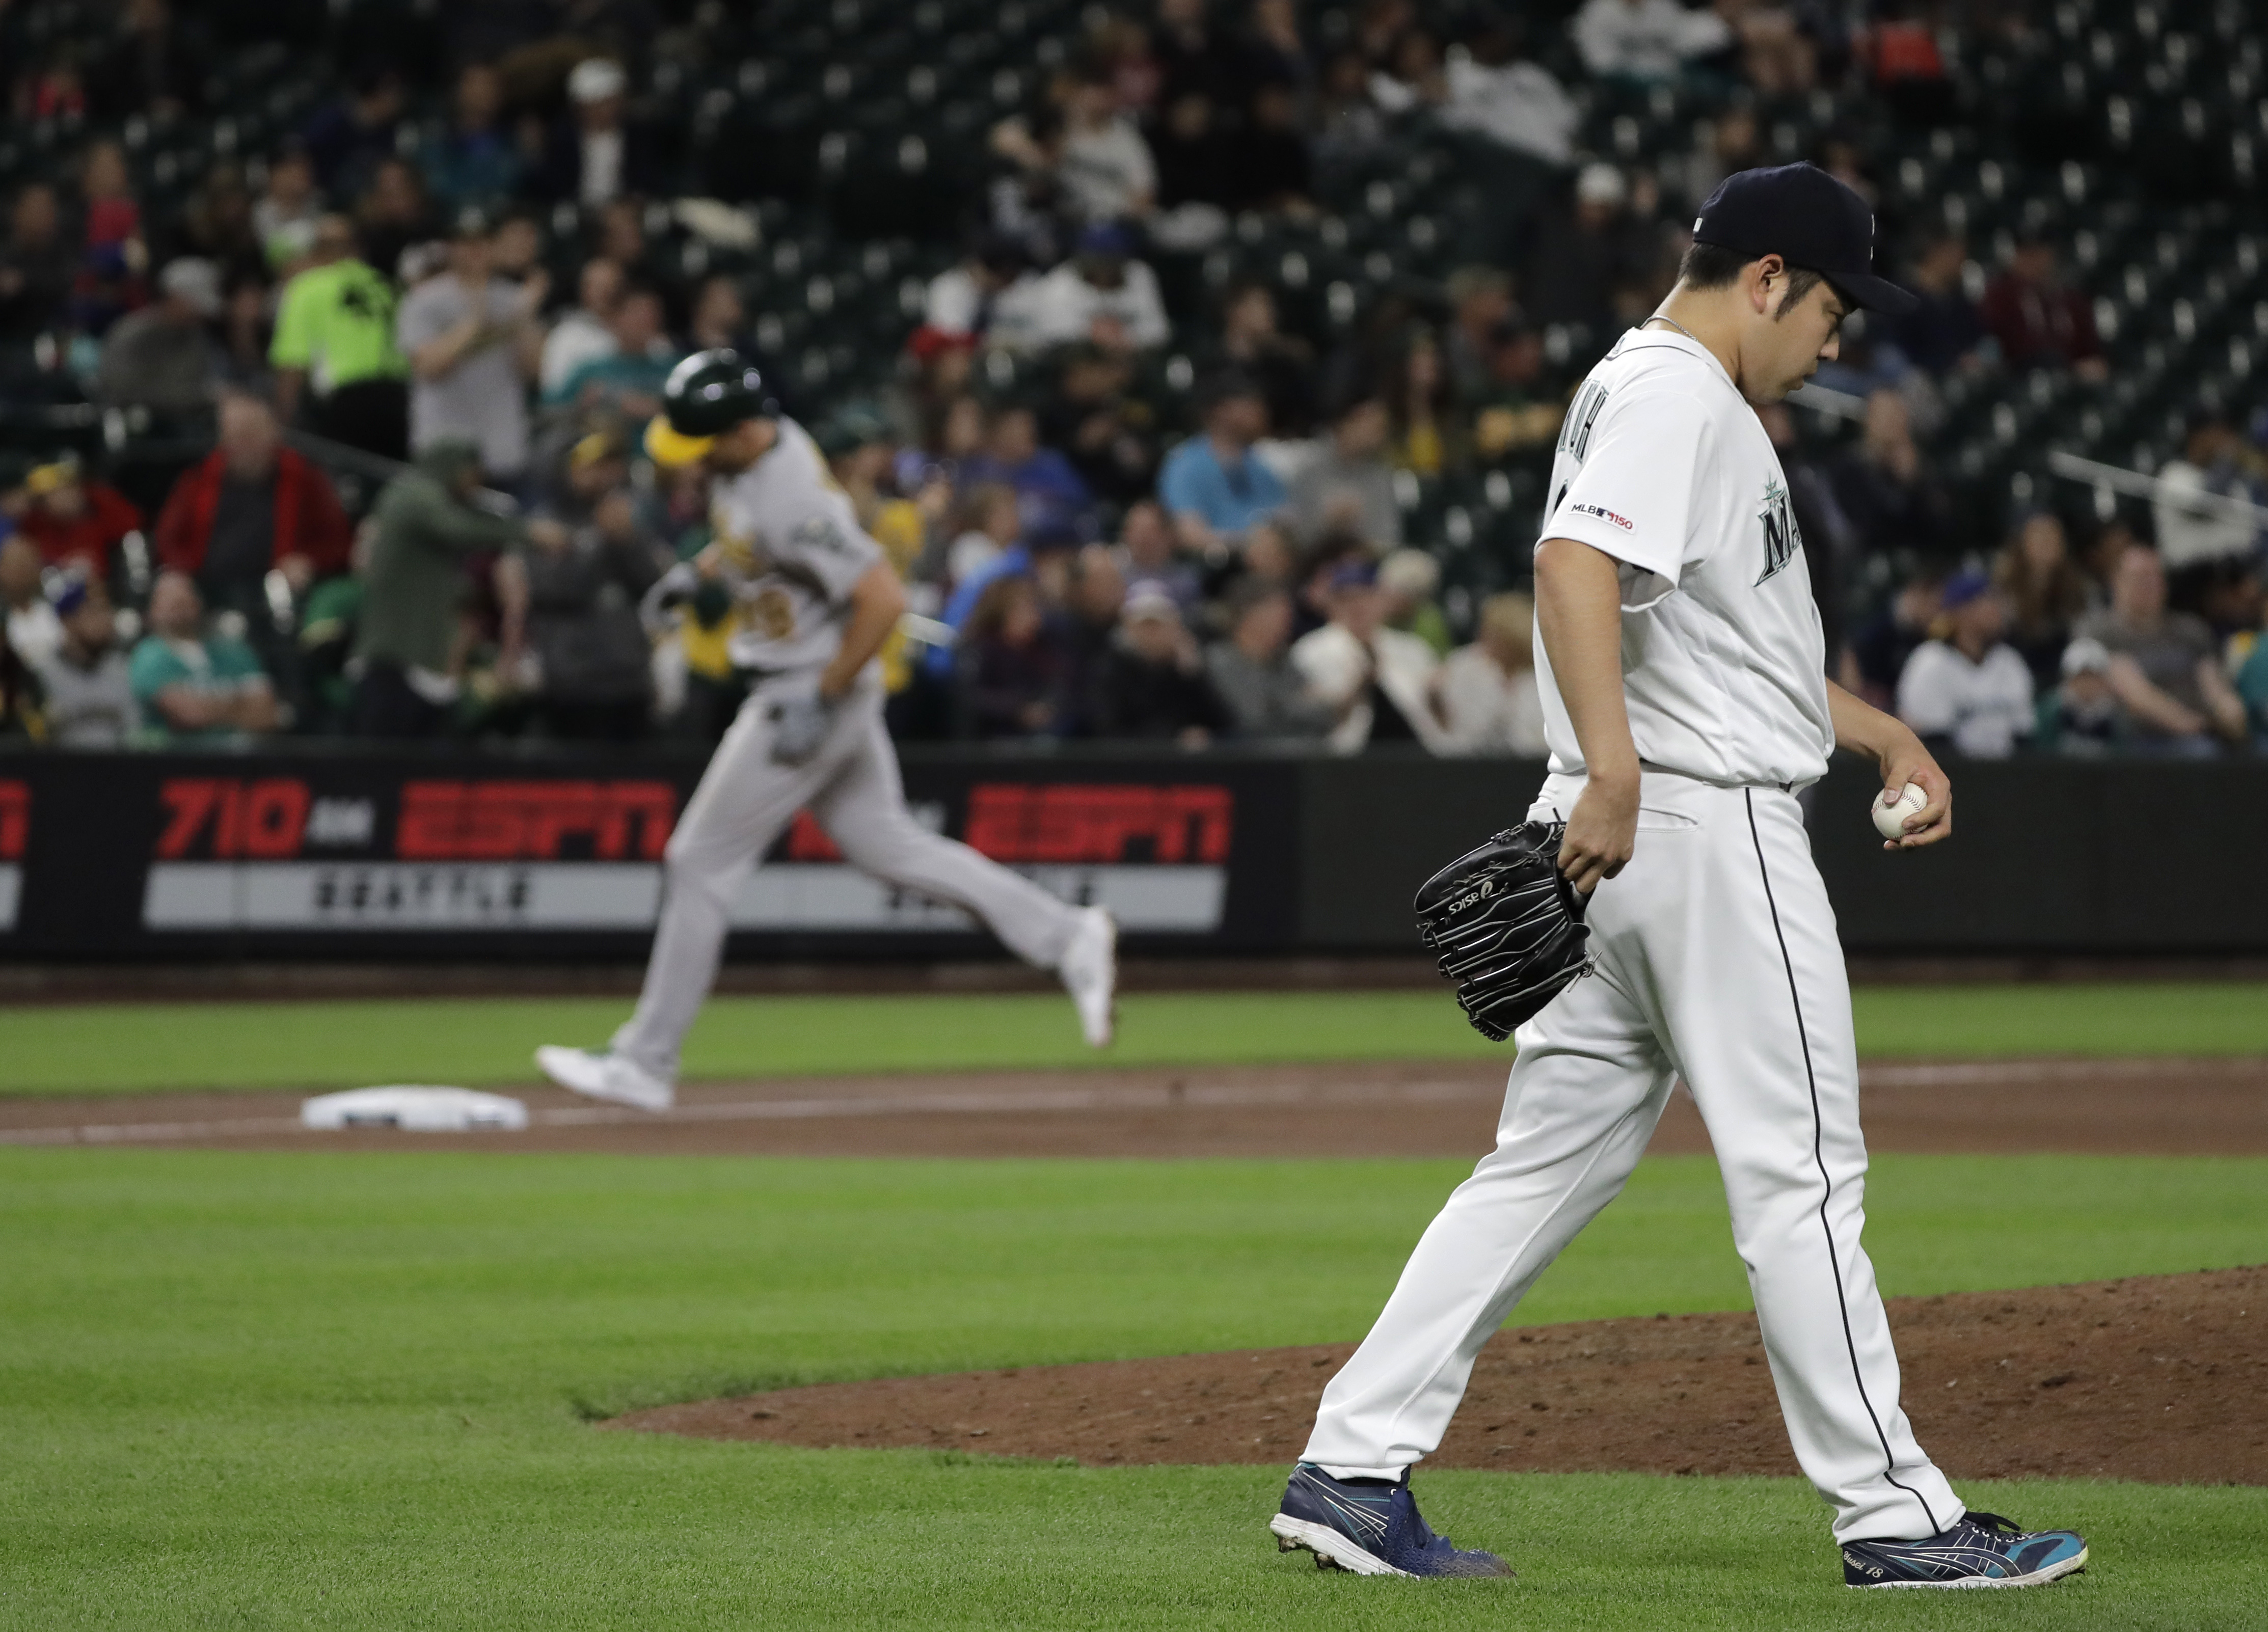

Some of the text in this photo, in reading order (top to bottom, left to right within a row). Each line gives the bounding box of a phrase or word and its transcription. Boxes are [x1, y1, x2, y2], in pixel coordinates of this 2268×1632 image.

[1571, 504, 1596, 514] MLB
[155, 779, 309, 860] 710
[395, 779, 677, 861] ESPN
[964, 783, 1233, 862] ESPN
[1448, 892, 1479, 915] asics
[1844, 1551, 1883, 1577] Yusei 18
